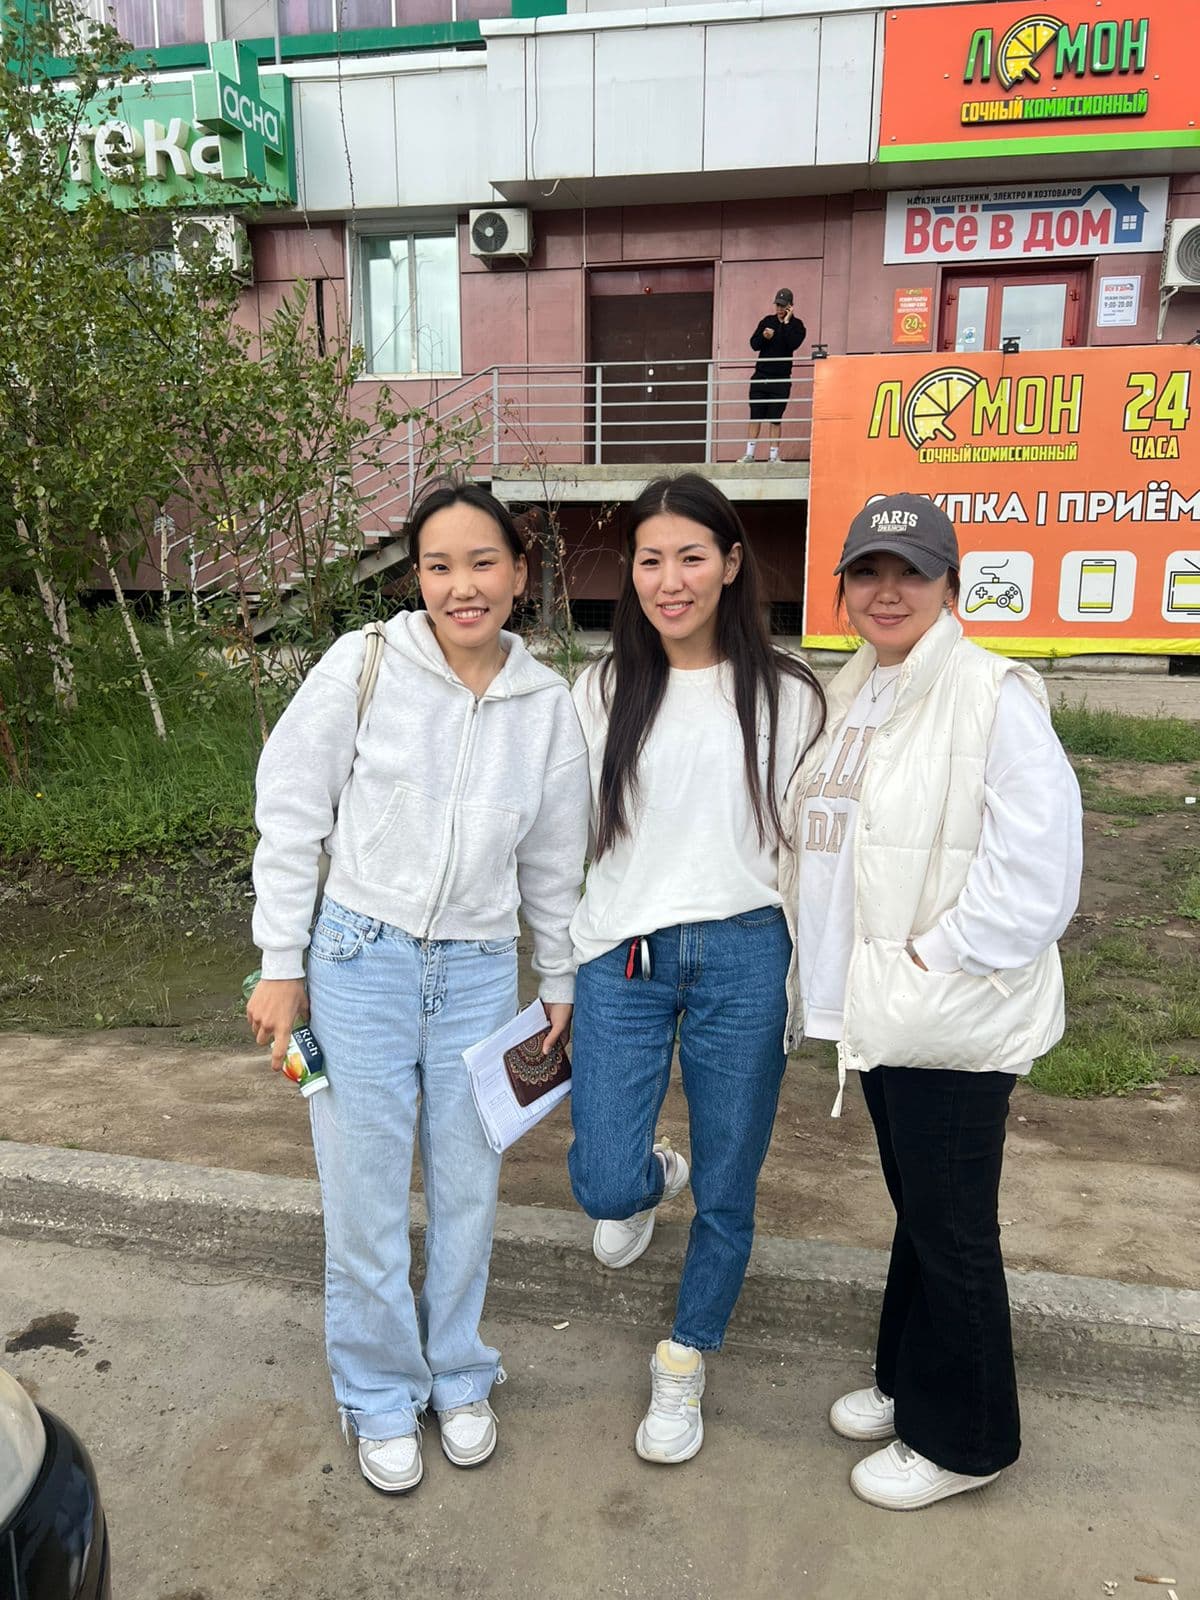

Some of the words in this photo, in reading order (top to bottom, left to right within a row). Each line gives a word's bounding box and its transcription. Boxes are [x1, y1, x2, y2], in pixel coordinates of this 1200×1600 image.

[961, 97, 1023, 122] СОЧНЫЙ
[1023, 89, 1148, 119] КОМИССИОННЫЙ
[907, 196, 940, 206] МАГАЗИН
[993, 190, 1026, 200] ЭЛЕКТРО
[1034, 188, 1082, 198] ХОЗТОВАРОВ
[904, 204, 978, 255] Всё
[1122, 370, 1191, 432] 24
[919, 444, 972, 464] СОЧНЫЙ
[972, 442, 1078, 462] КОМИССИОННЫЙ
[1131, 435, 1180, 460] ЧАСА
[1057, 480, 1200, 522] ПРИЁМ
[870, 509, 919, 529] PARIS
[301, 1028, 318, 1056] Rich
